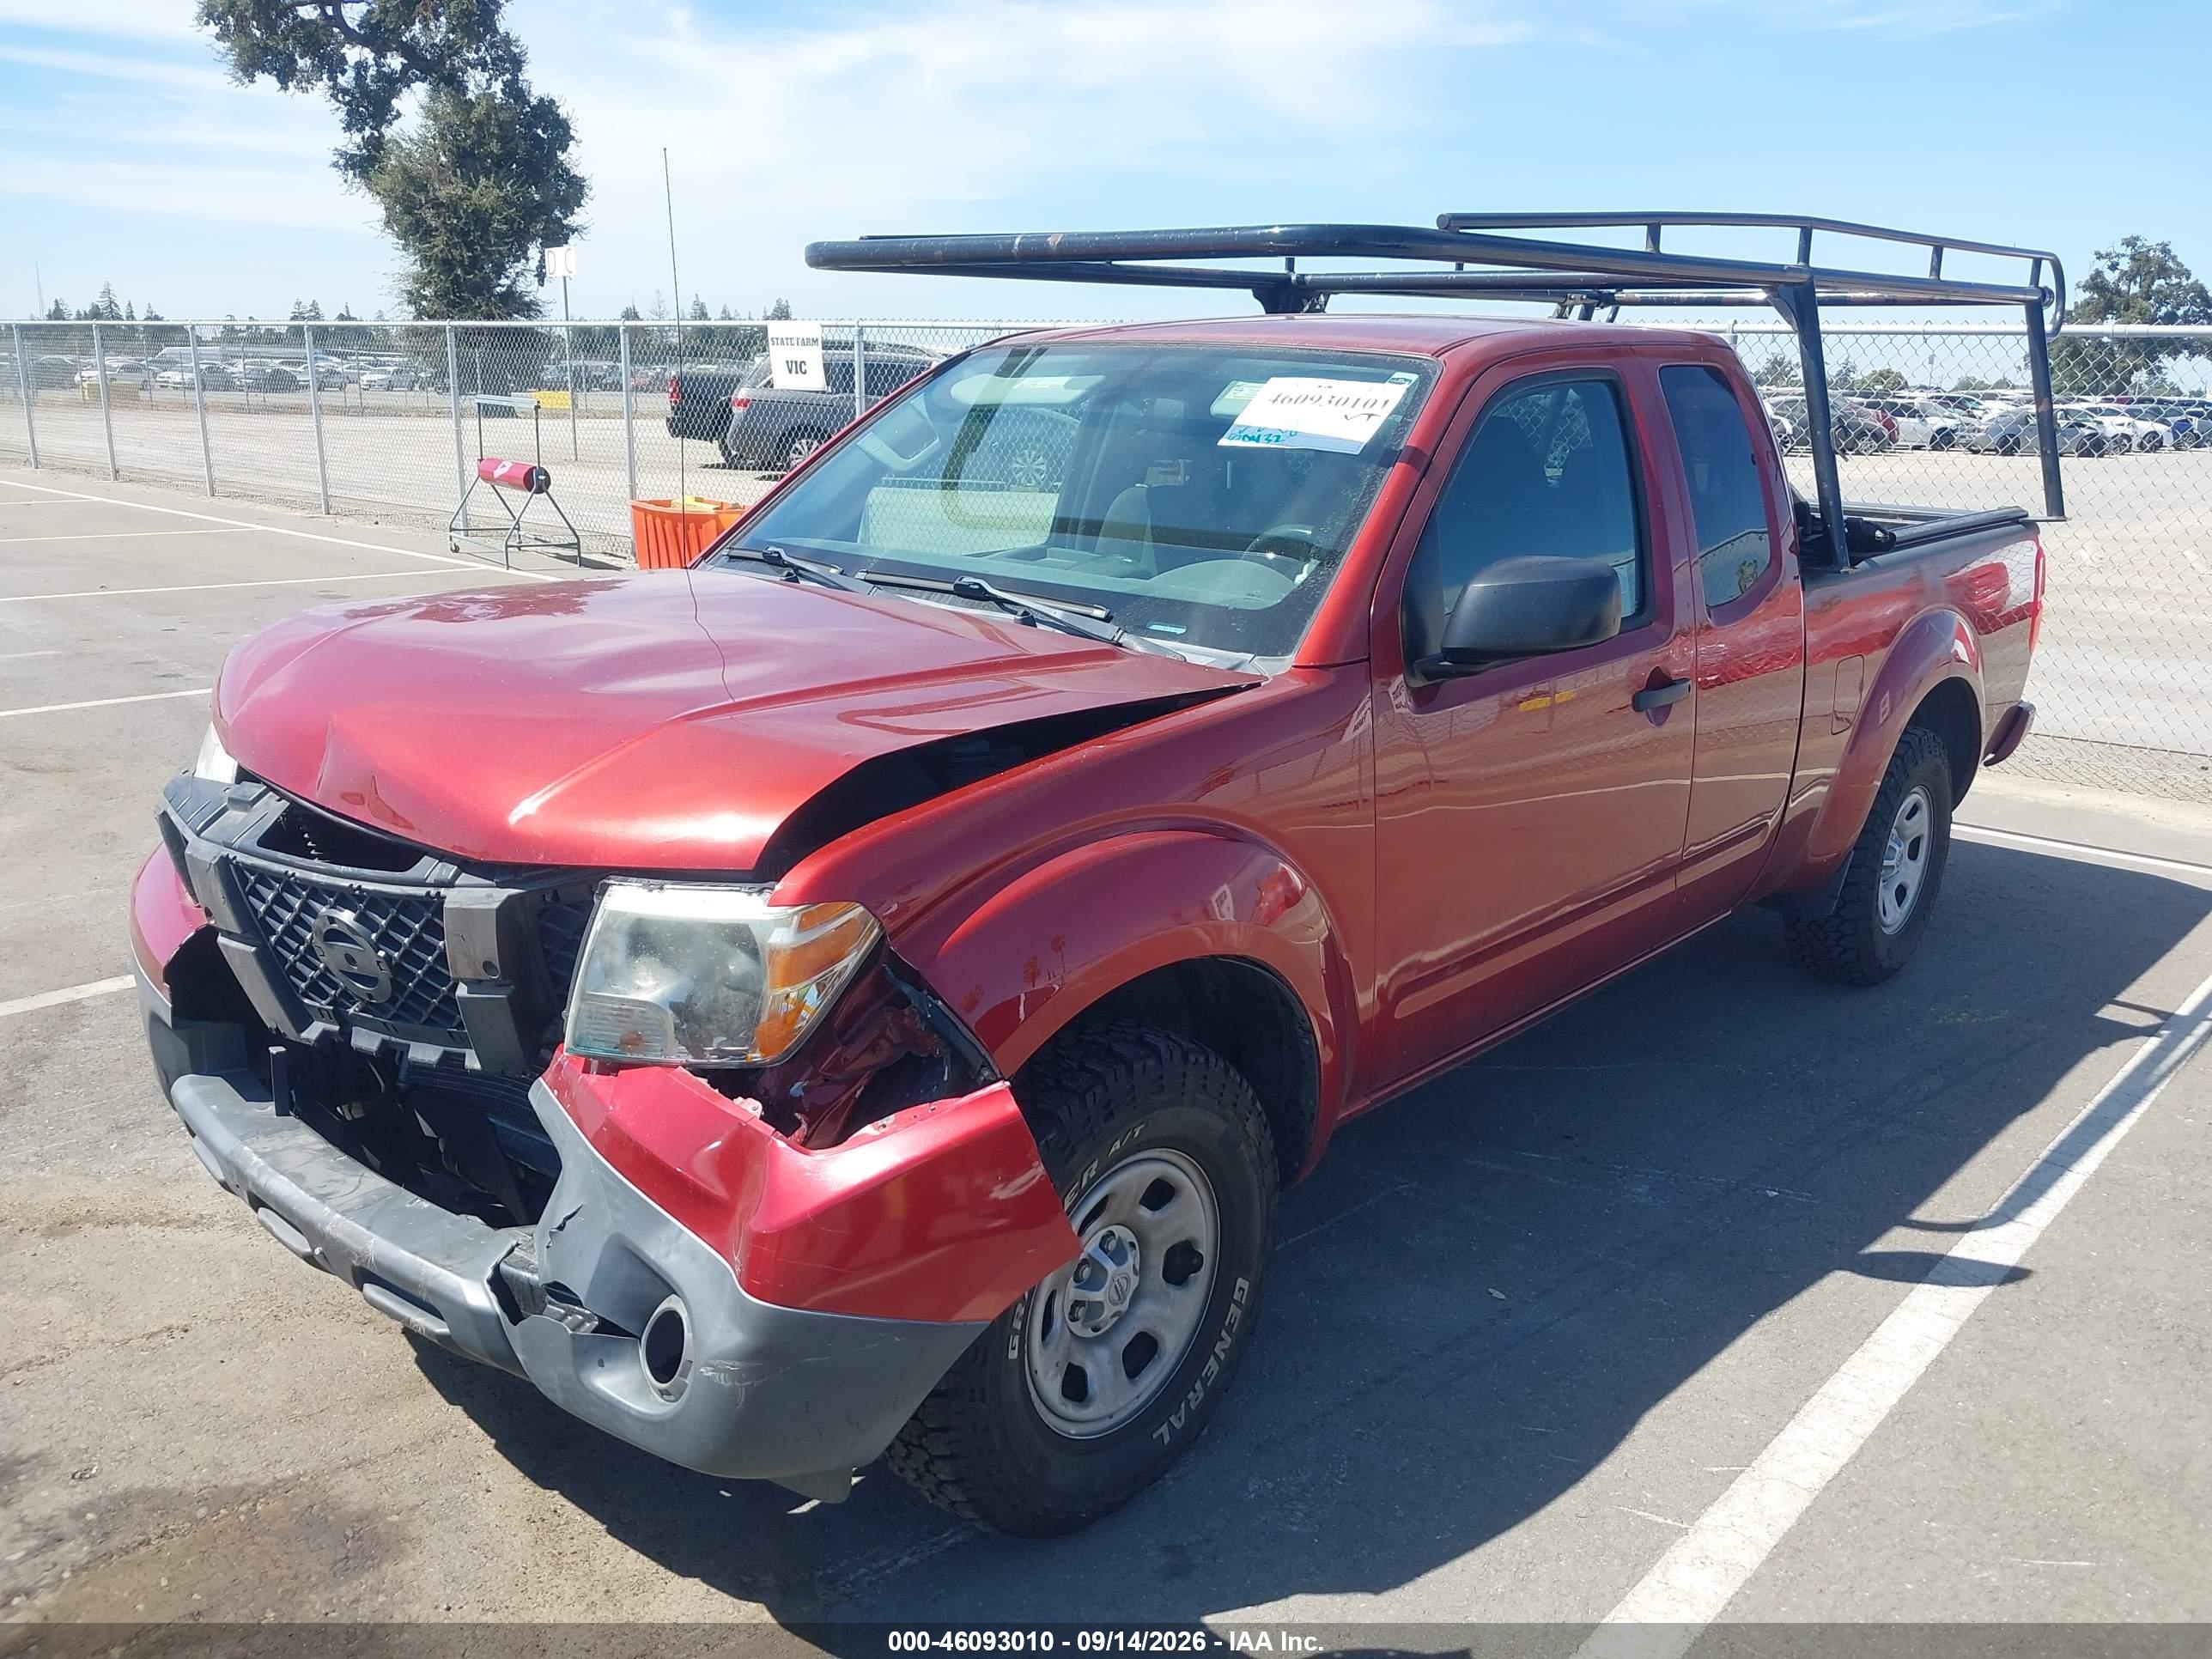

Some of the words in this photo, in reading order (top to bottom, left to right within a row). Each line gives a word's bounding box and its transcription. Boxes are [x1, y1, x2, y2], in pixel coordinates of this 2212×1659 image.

[770, 337, 795, 347] STATE
[797, 337, 820, 347] FARM
[786, 360, 807, 375] VIC
[1107, 1121, 1146, 1158] A/T
[1152, 1277, 1250, 1446] GENERAL
